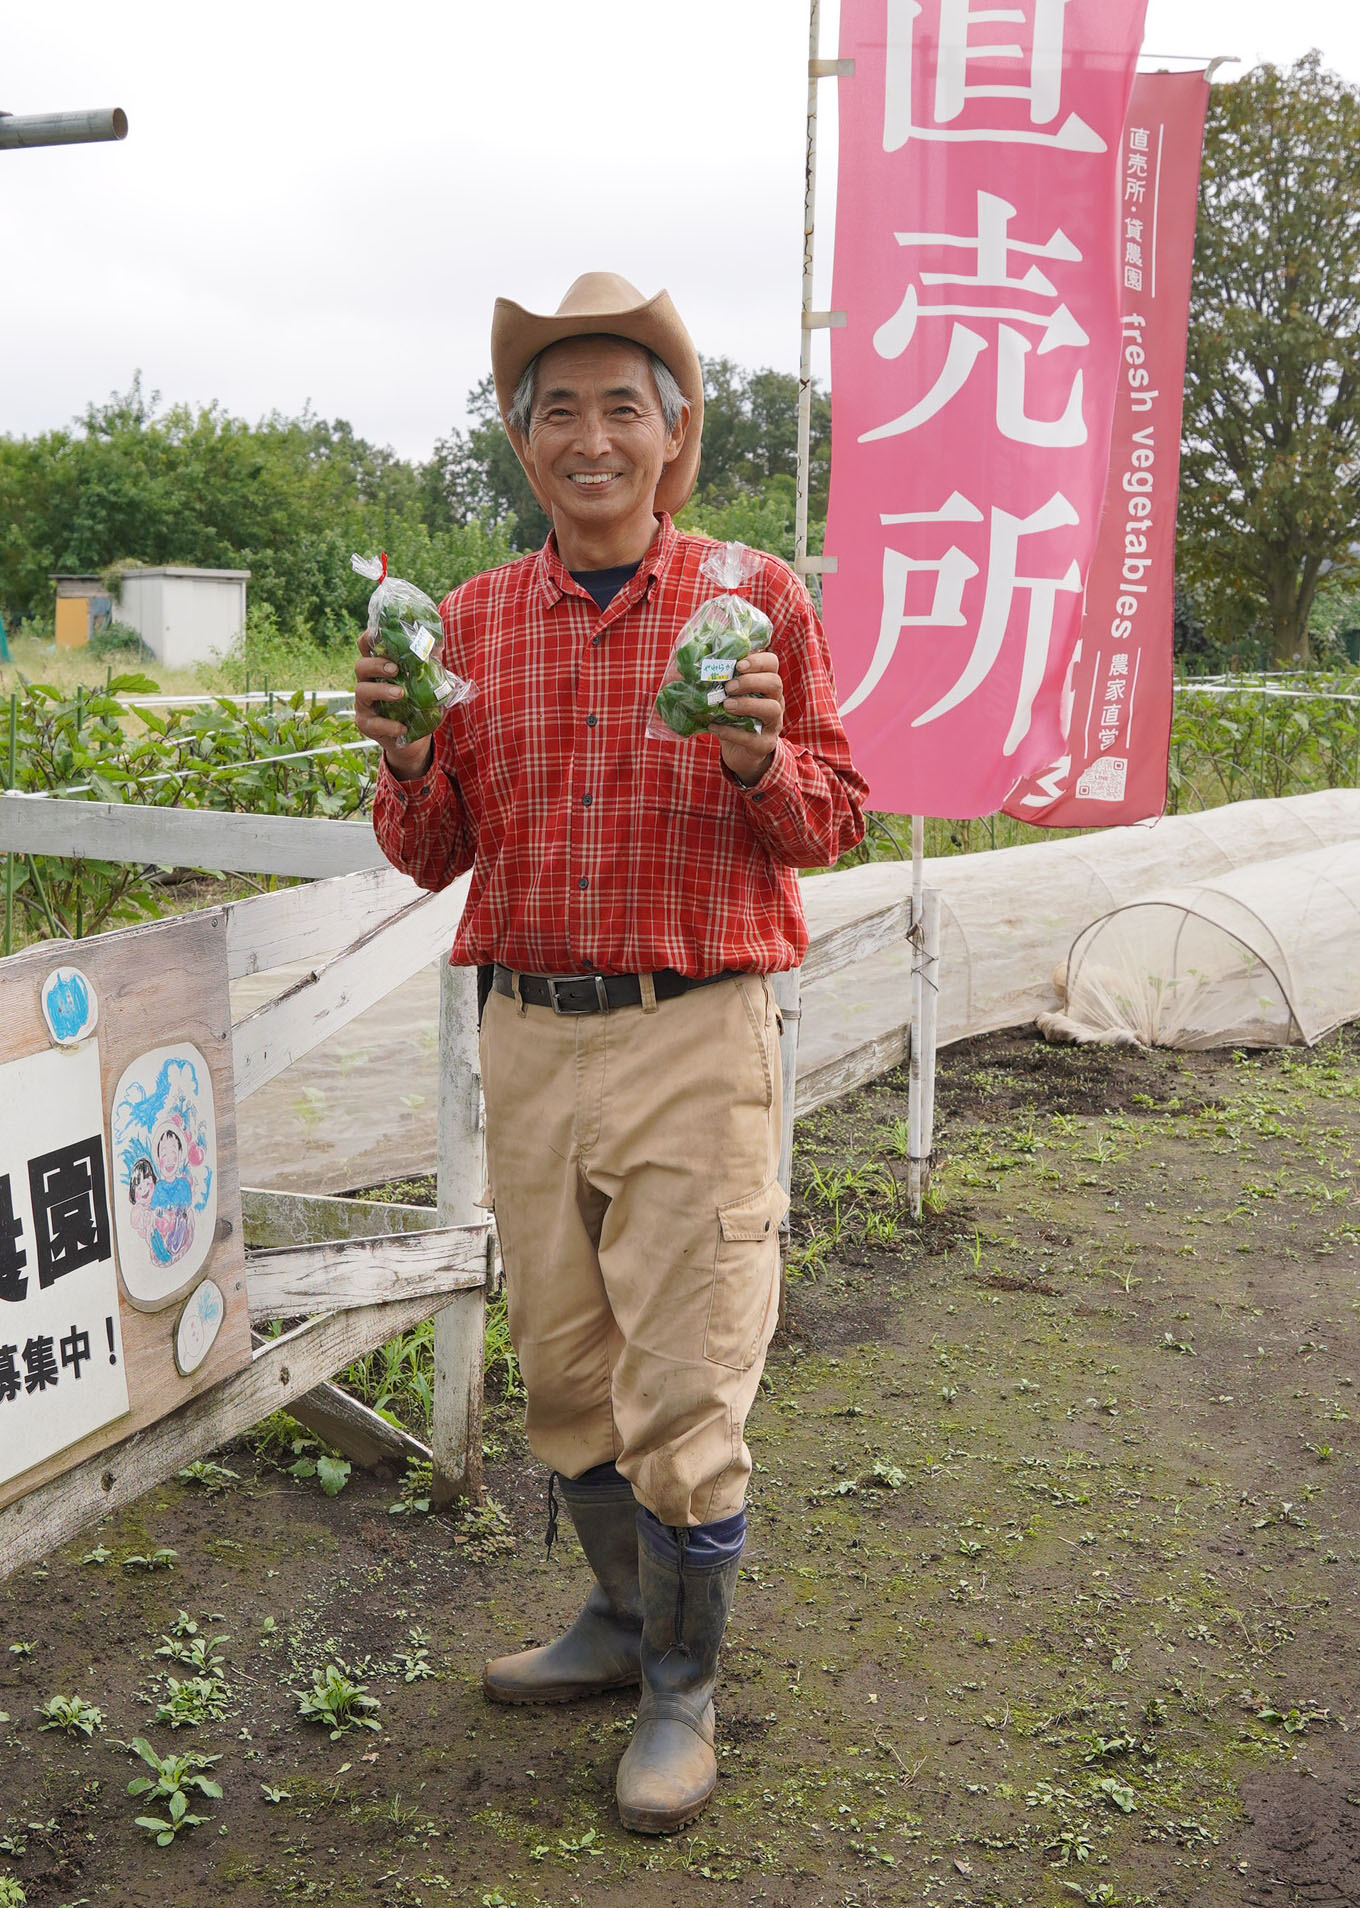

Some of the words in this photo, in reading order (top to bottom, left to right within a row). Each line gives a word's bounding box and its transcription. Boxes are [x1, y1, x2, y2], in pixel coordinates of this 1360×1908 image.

[839, 0, 1108, 756] 直売所
[1120, 313, 1159, 412] fresh
[1111, 426, 1154, 639] vegetables
